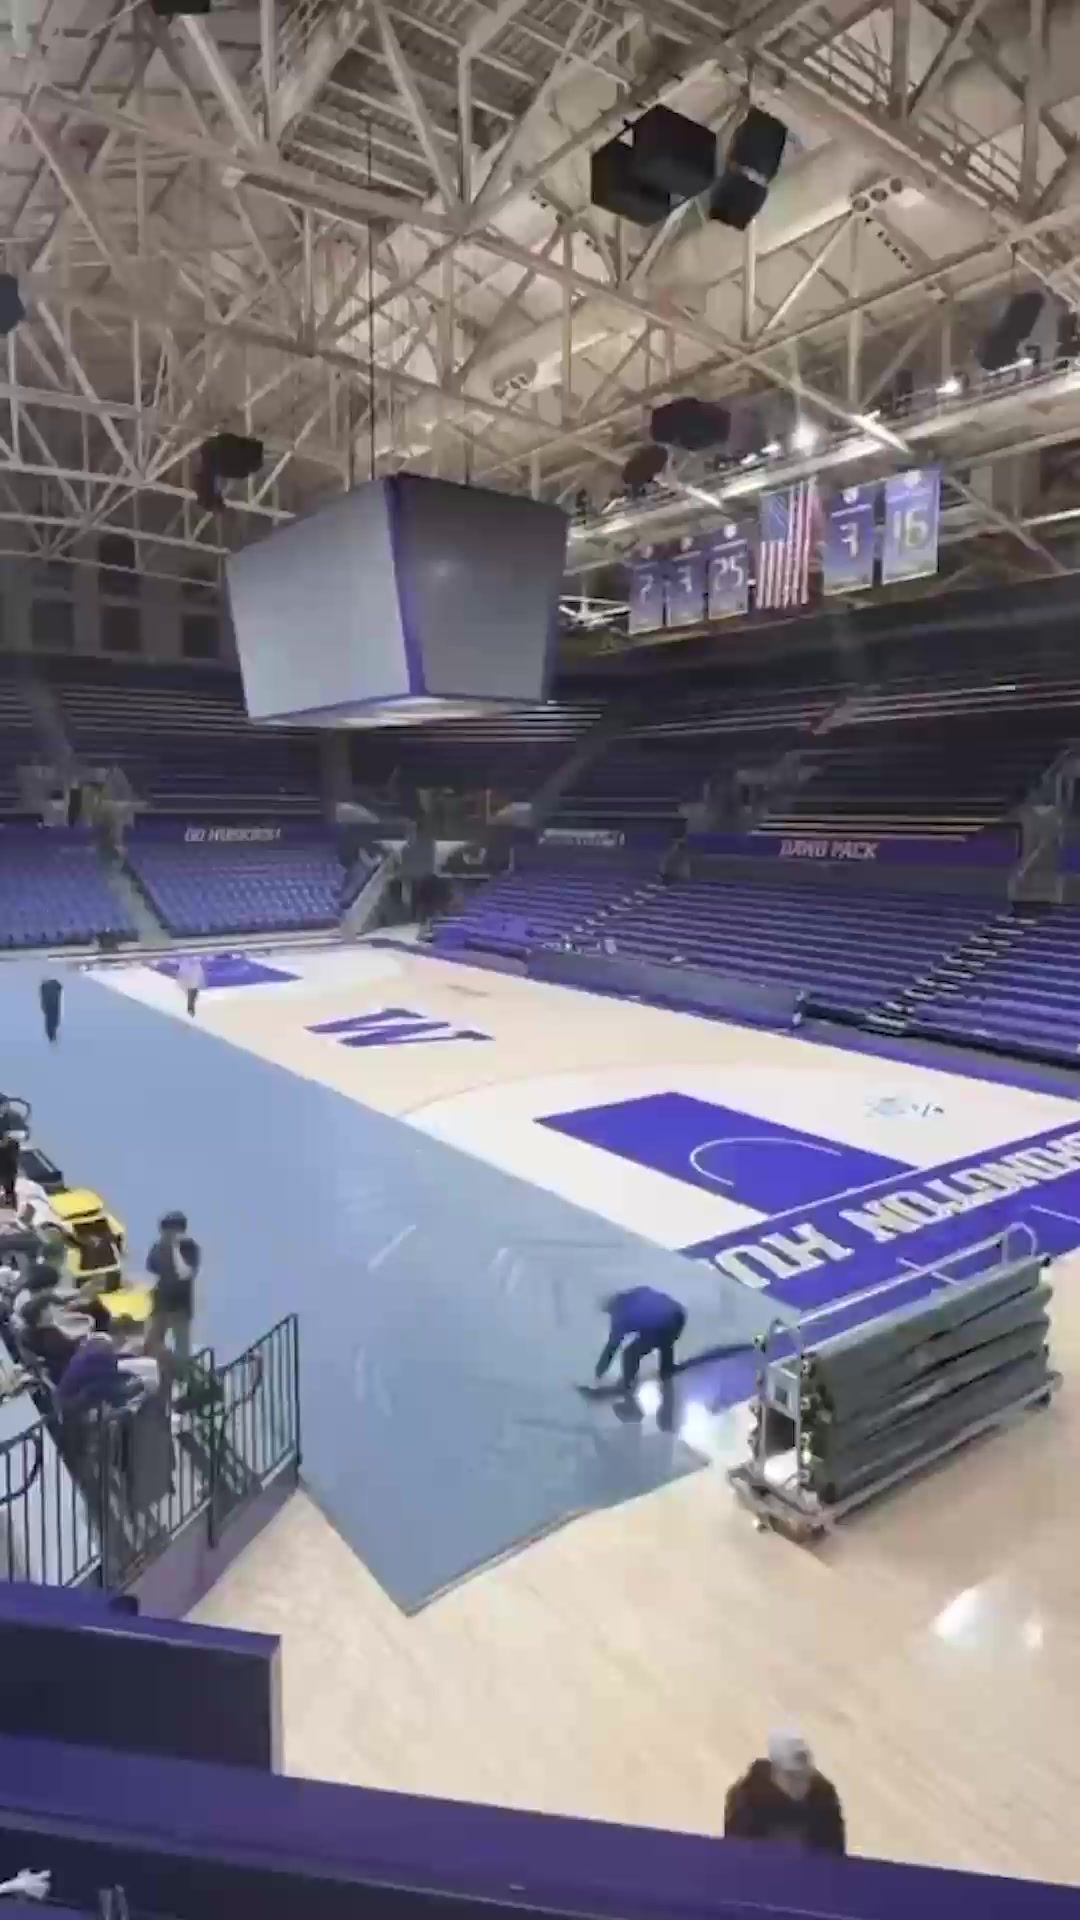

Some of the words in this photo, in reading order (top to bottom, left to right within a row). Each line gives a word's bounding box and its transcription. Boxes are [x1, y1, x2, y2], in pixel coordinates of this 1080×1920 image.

[893, 508, 930, 552] 16
[712, 555, 745, 592] 25
[831, 840, 879, 860] PACK
[839, 1133, 1080, 1243] HINGTON
[710, 1222, 855, 1289] HU
